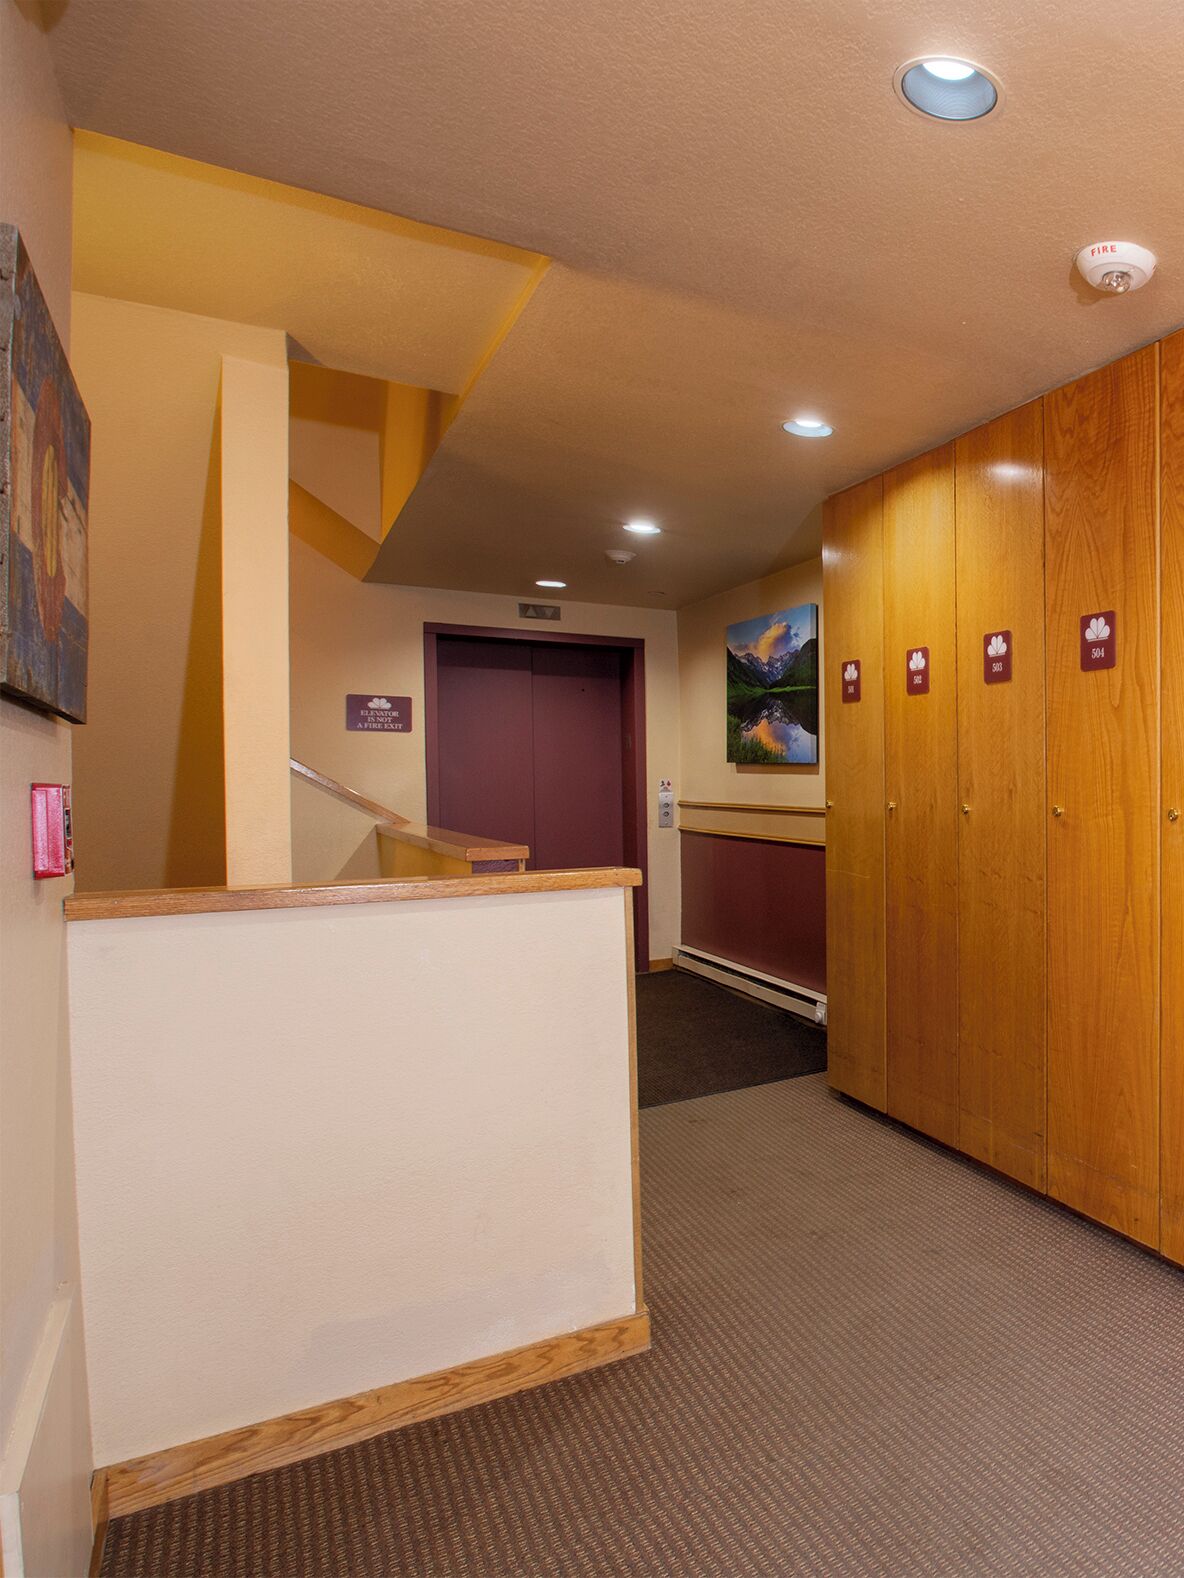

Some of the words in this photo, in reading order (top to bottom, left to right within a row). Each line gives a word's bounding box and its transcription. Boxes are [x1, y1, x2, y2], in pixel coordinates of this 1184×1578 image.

[1091, 245, 1117, 257] FIRE
[1091, 647, 1105, 659] 504
[992, 662, 1003, 673] 503
